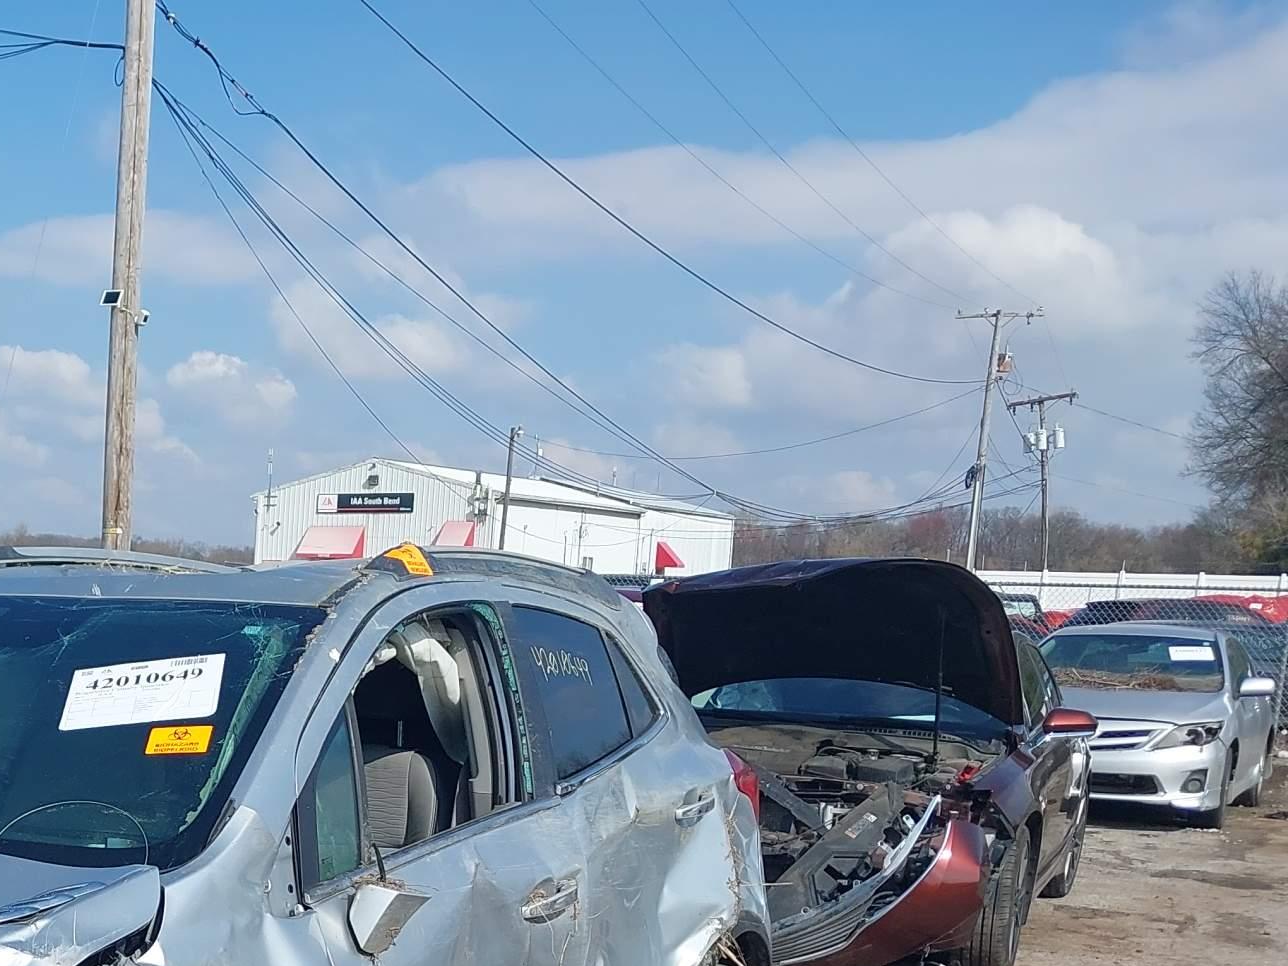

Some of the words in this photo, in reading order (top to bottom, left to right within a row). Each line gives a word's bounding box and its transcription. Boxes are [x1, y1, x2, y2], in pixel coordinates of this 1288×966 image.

[350, 497, 362, 505] IAA
[363, 497, 382, 505] South
[383, 497, 401, 505] Bend
[86, 667, 204, 690] 42010649
